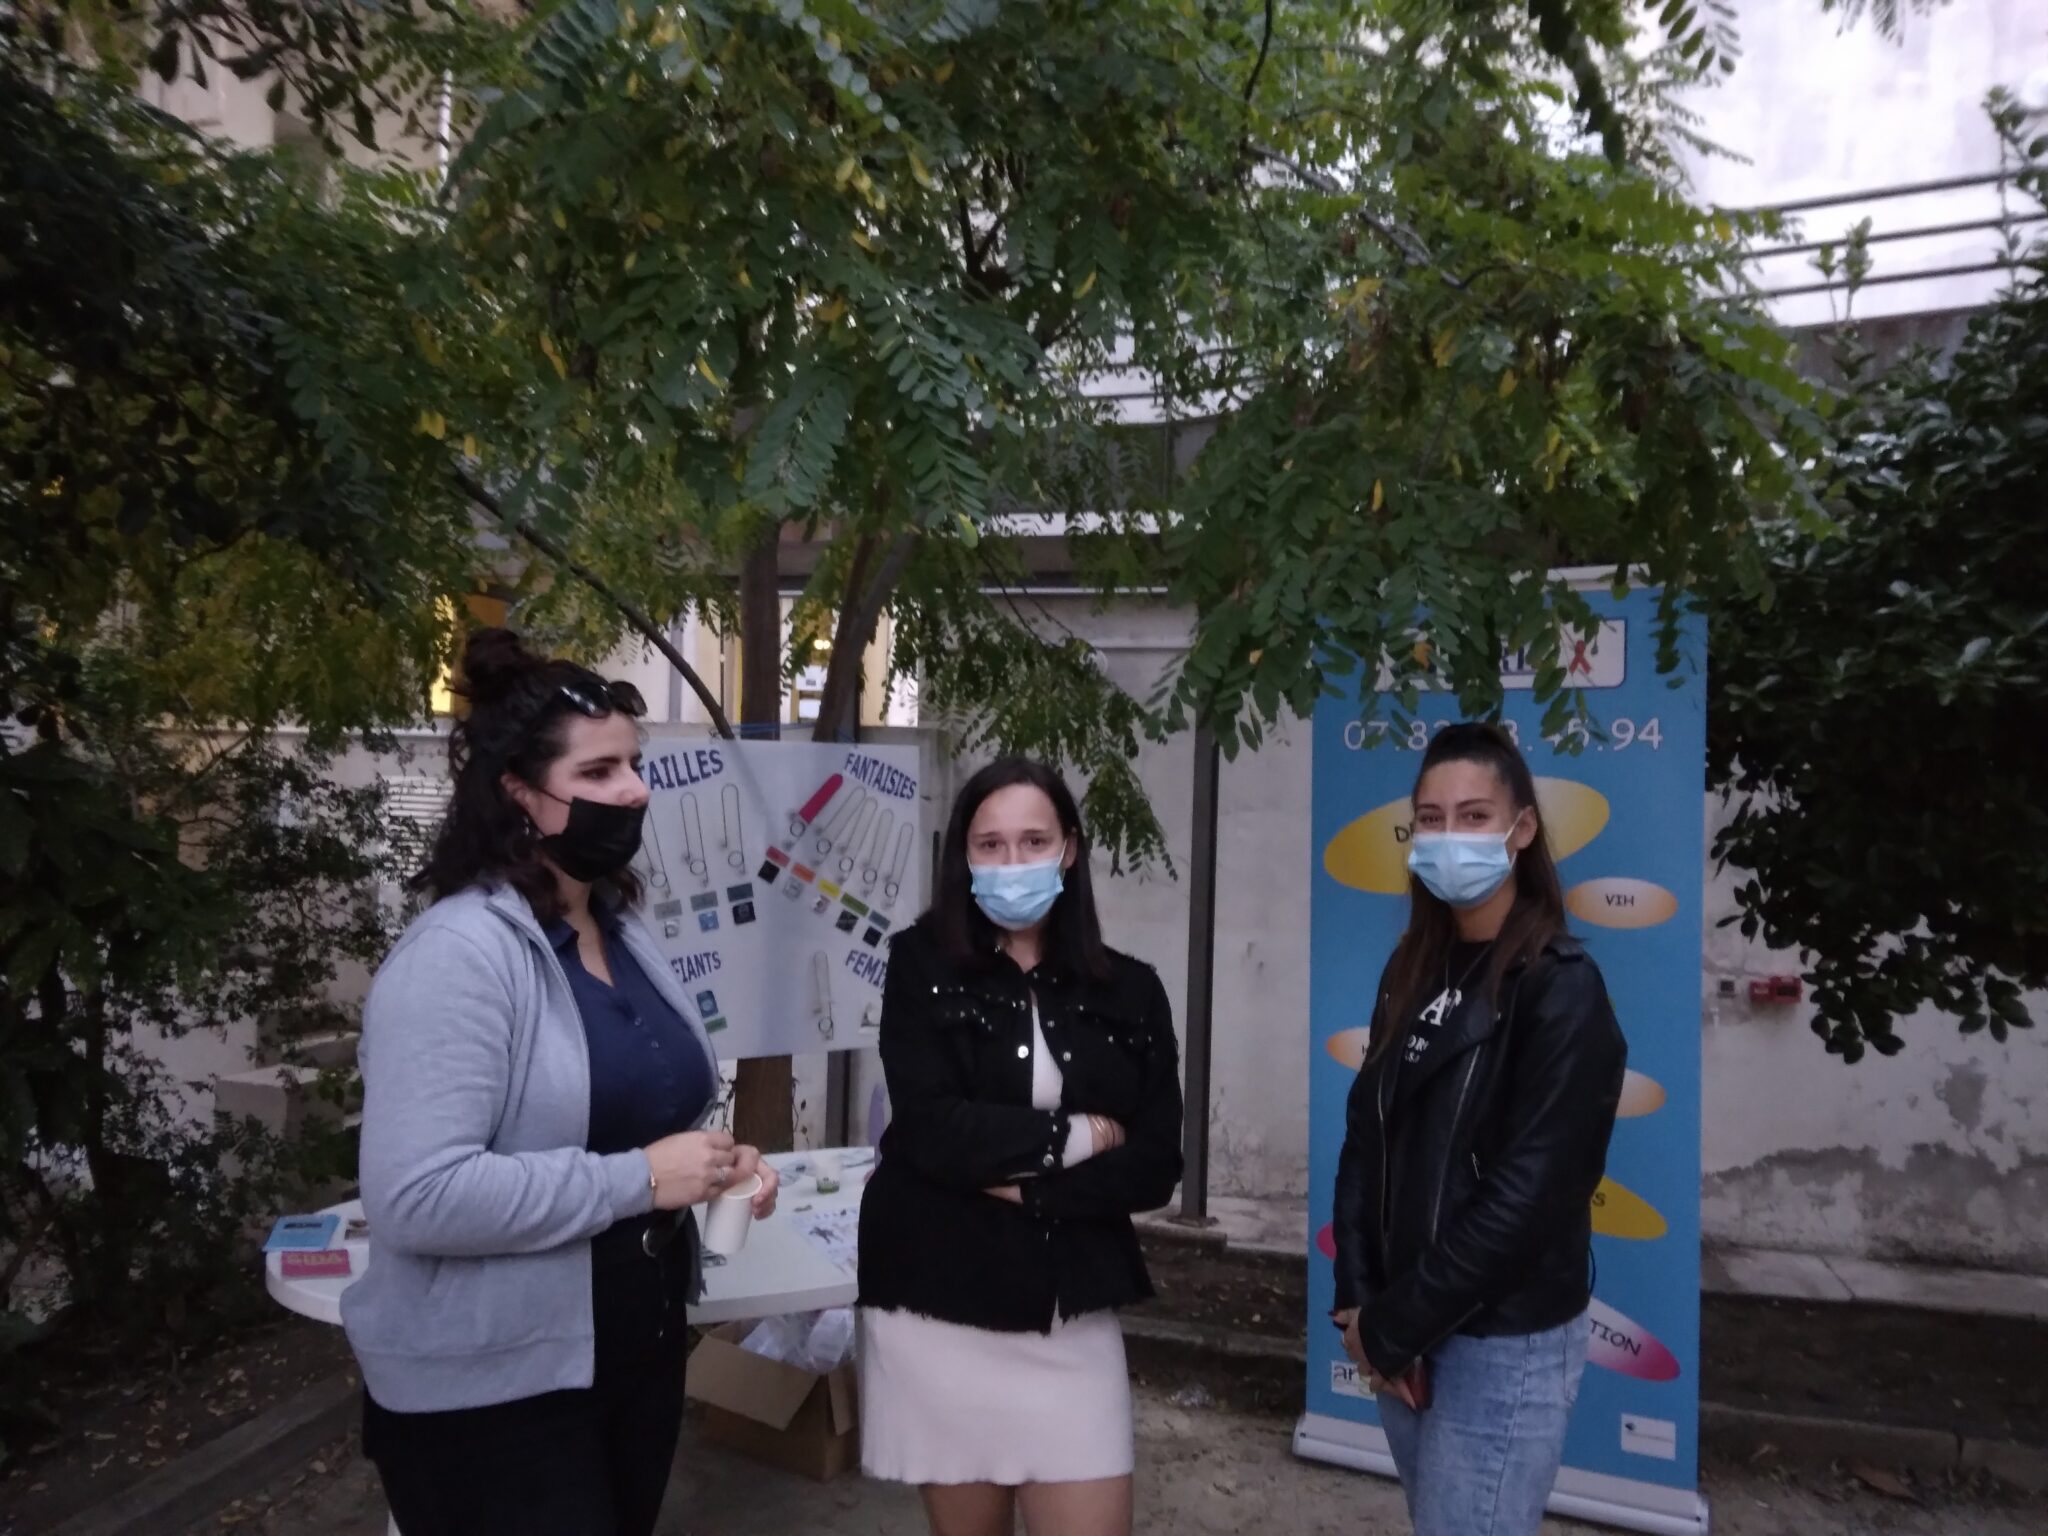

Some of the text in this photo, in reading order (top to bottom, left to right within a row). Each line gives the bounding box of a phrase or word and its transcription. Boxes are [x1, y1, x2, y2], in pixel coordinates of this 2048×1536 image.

[845, 752, 917, 800] FANTAISIES
[1605, 894, 1635, 907] VIH
[845, 949, 887, 988] FEMI
[1590, 1318, 1642, 1357] TION
